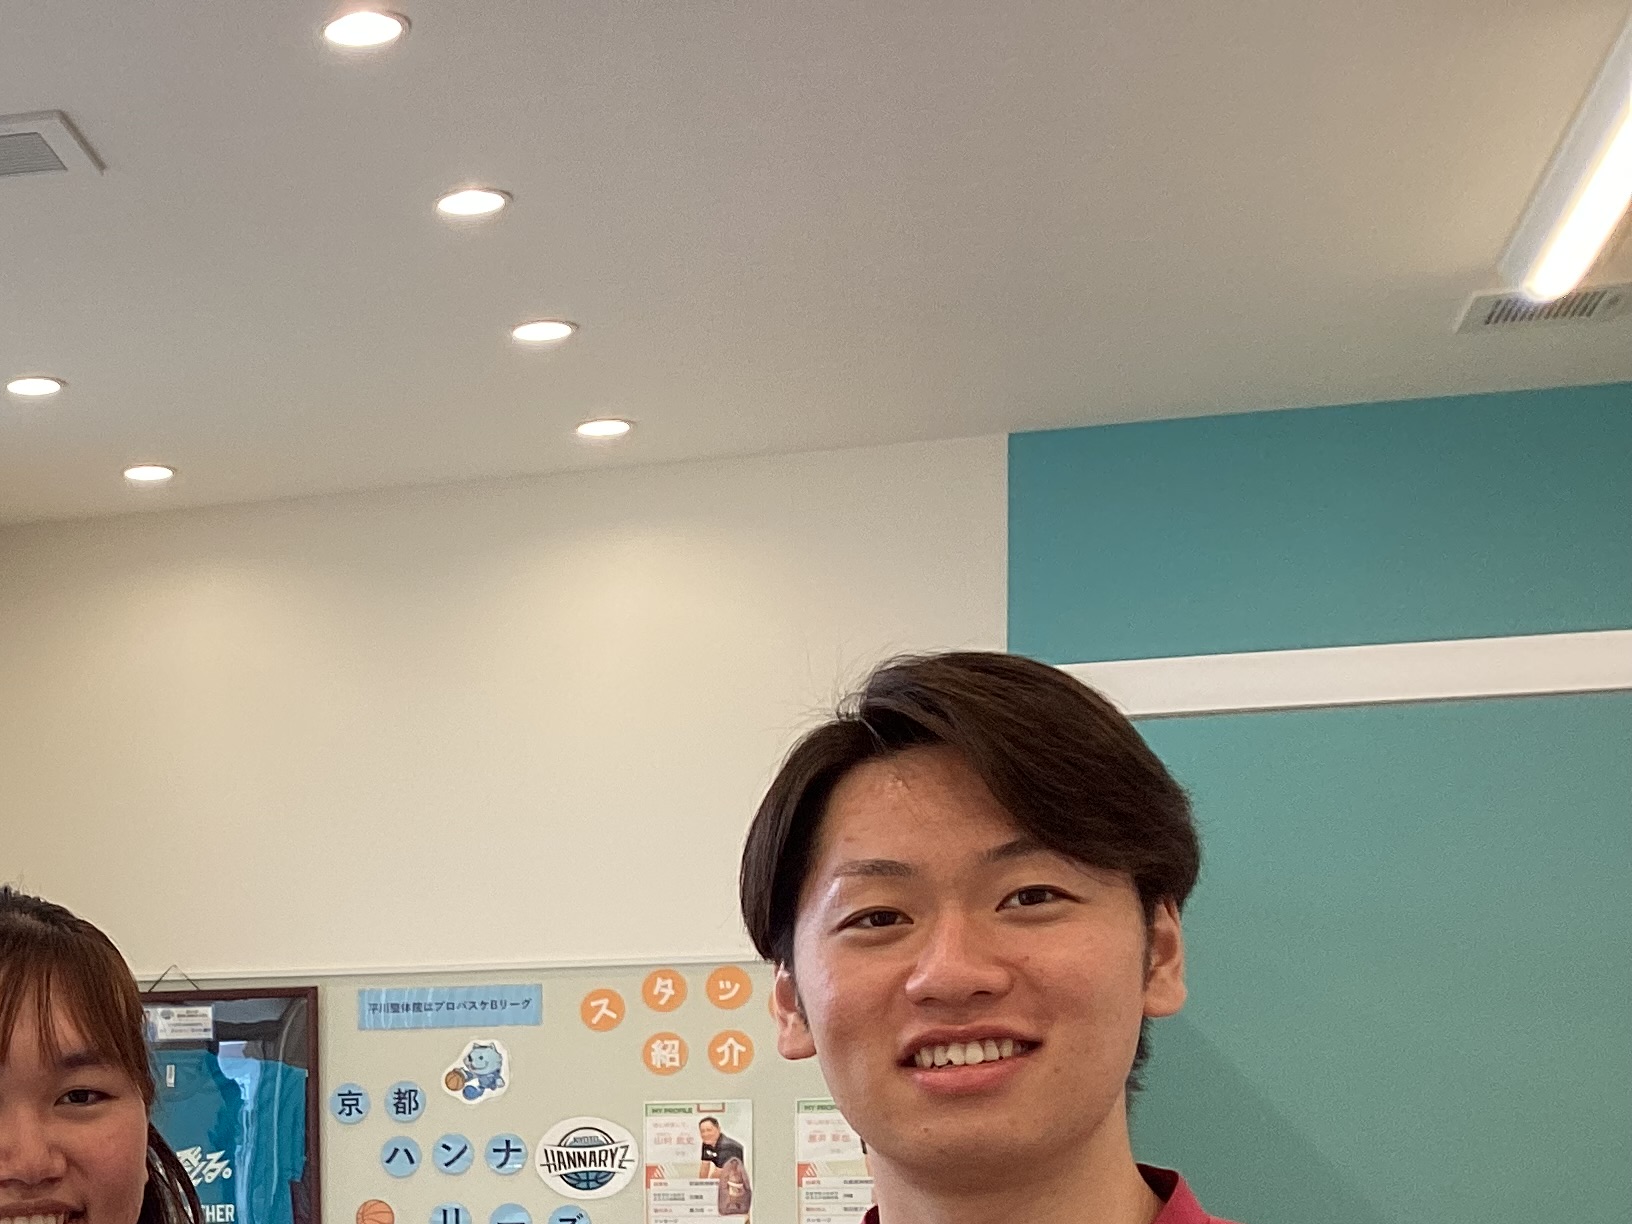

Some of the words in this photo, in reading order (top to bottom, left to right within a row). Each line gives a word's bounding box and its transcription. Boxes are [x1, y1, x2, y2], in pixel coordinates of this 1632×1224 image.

[589, 975, 741, 1025] スタッ
[650, 1036, 747, 1068] 紹介
[336, 1087, 420, 1117] 京都
[384, 1138, 523, 1169] ハンナ
[540, 1144, 635, 1174] HANNARYZ
